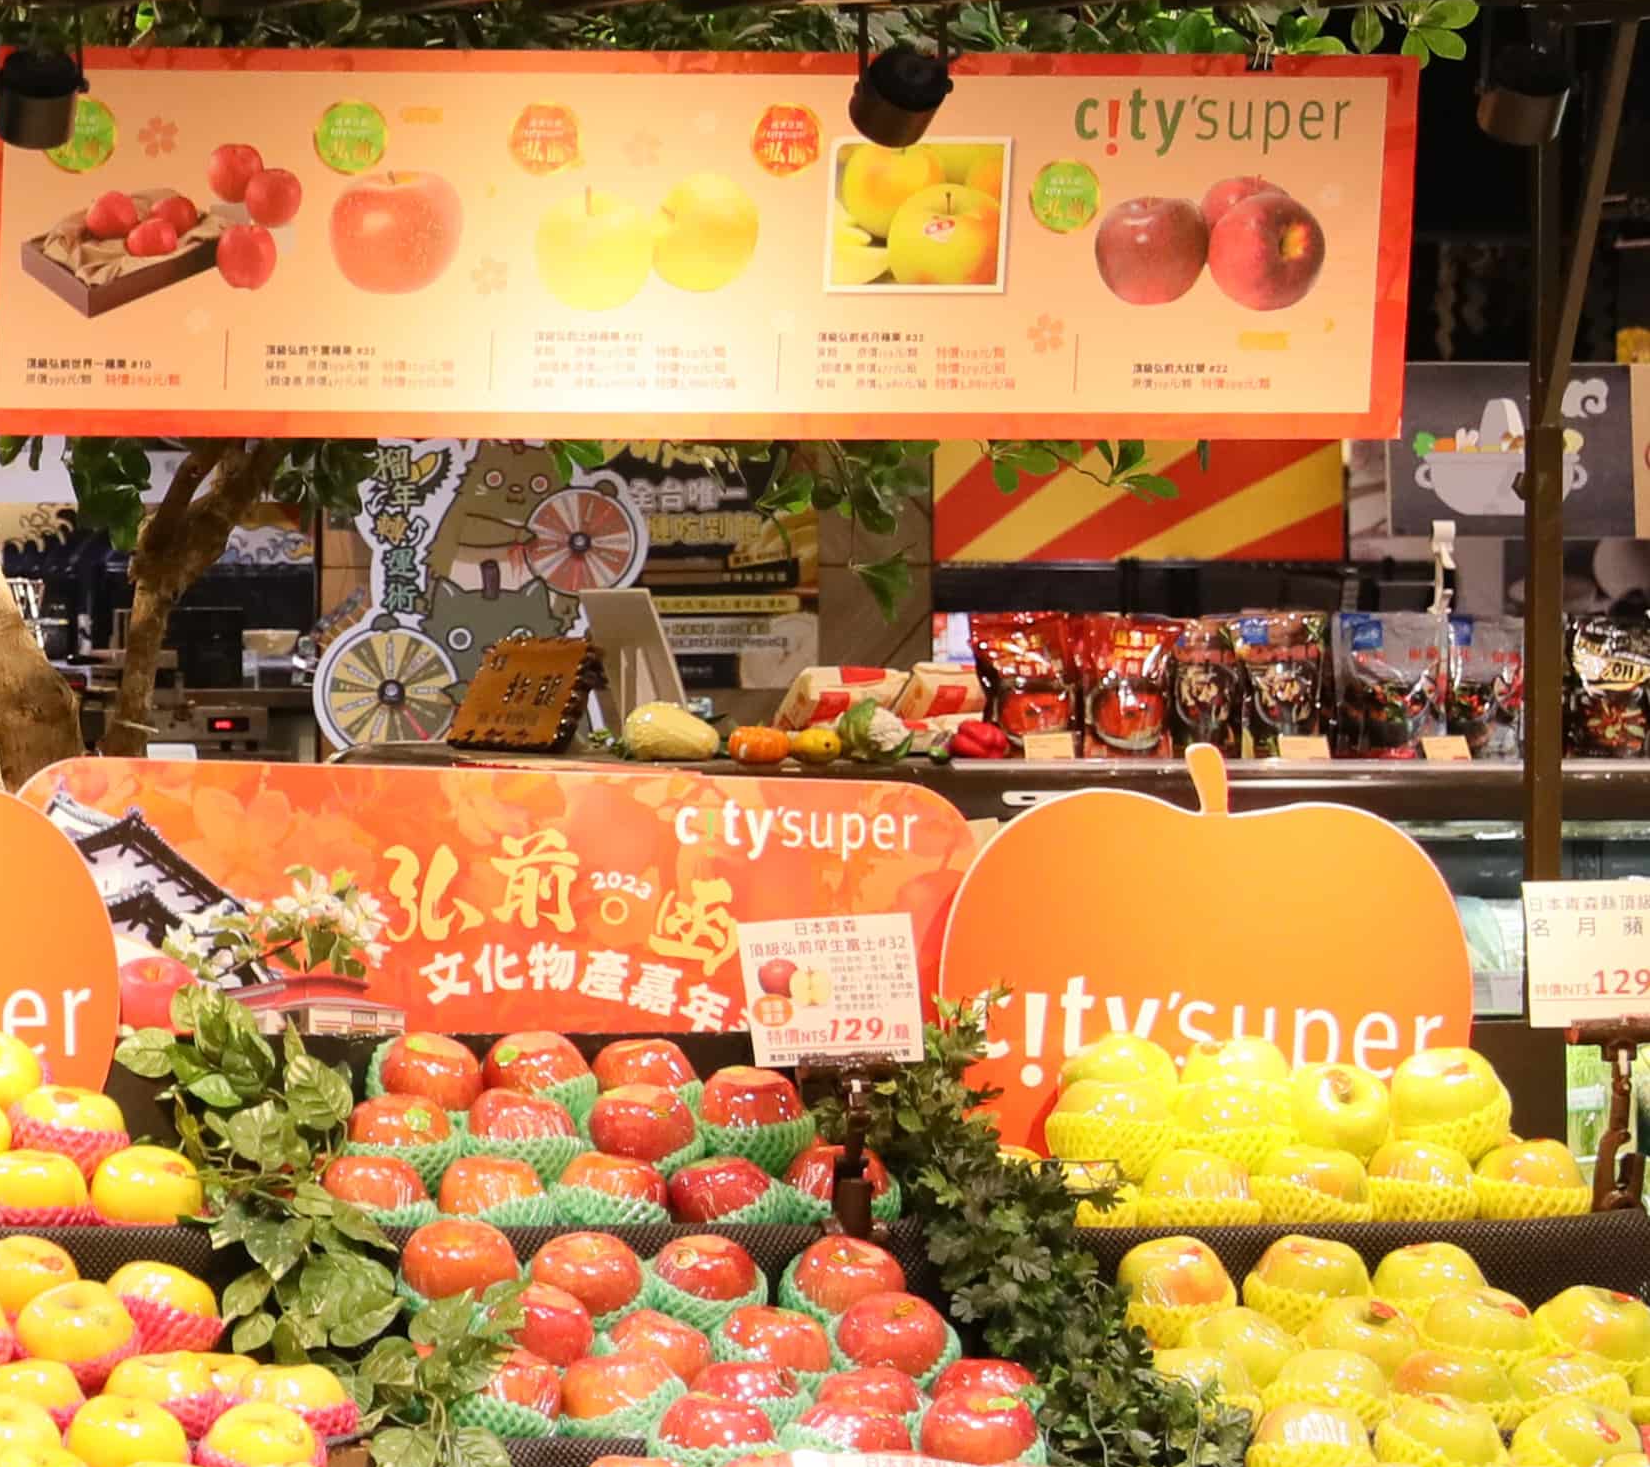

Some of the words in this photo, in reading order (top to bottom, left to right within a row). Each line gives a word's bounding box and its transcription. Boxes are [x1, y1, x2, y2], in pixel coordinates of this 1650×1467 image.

[385, 826, 580, 942] 弘前
[591, 869, 652, 900] 2023
[418, 941, 749, 1031] 文化物產嘉年
[1594, 968, 1650, 996] 129
[829, 1017, 884, 1043] 129
